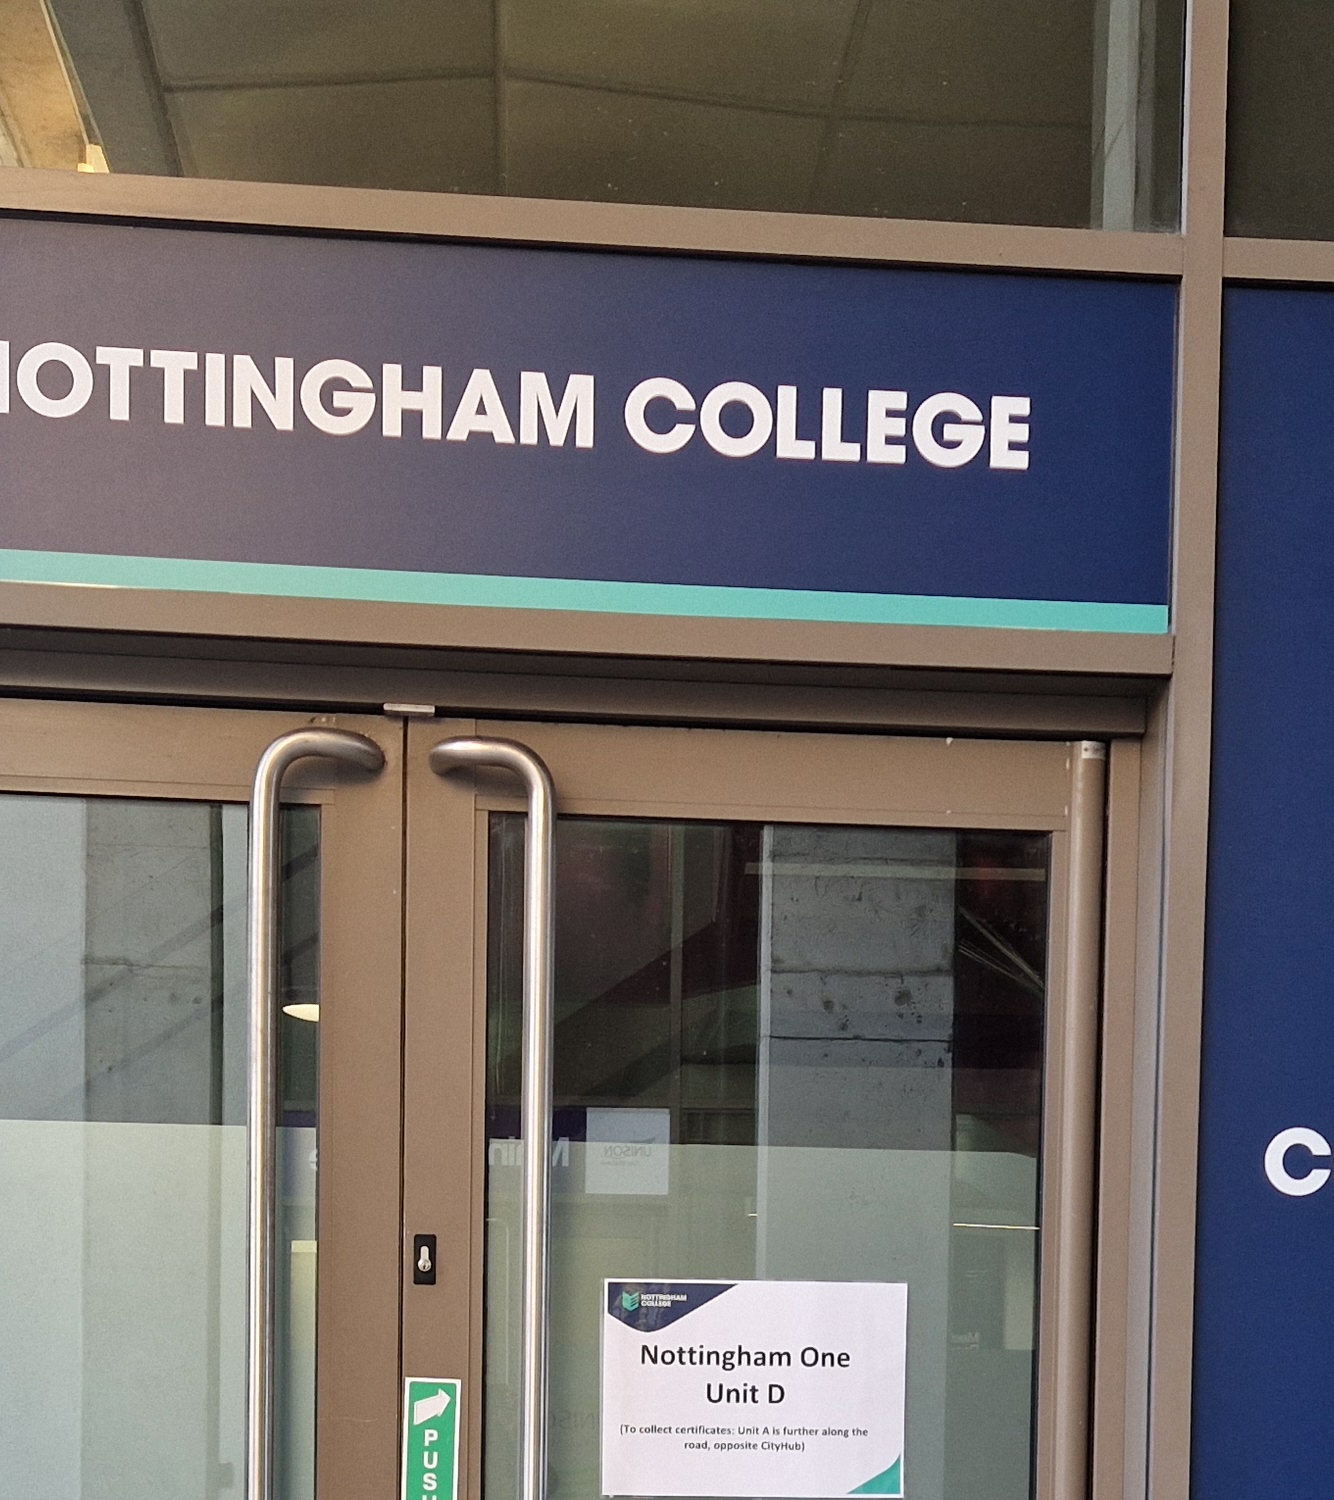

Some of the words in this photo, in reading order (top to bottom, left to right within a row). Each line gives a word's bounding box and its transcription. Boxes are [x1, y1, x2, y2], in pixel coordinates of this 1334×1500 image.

[624, 377, 1031, 470] COLLEGE
[641, 1344, 792, 1372] Nottingham
[800, 1346, 851, 1368] One
[706, 1382, 759, 1404] Unit
[768, 1383, 785, 1404] D
[619, 1424, 637, 1436] (To
[638, 1424, 673, 1434] collect
[675, 1425, 735, 1435] certificates:
[737, 1426, 760, 1435] Unit
[761, 1426, 770, 1435] A
[772, 1426, 781, 1435] is
[782, 1426, 819, 1436] further
[821, 1426, 850, 1439] along
[851, 1427, 869, 1437] the
[684, 1440, 711, 1451] road,
[713, 1441, 759, 1452] opposite
[760, 1440, 805, 1453] CityHub)
